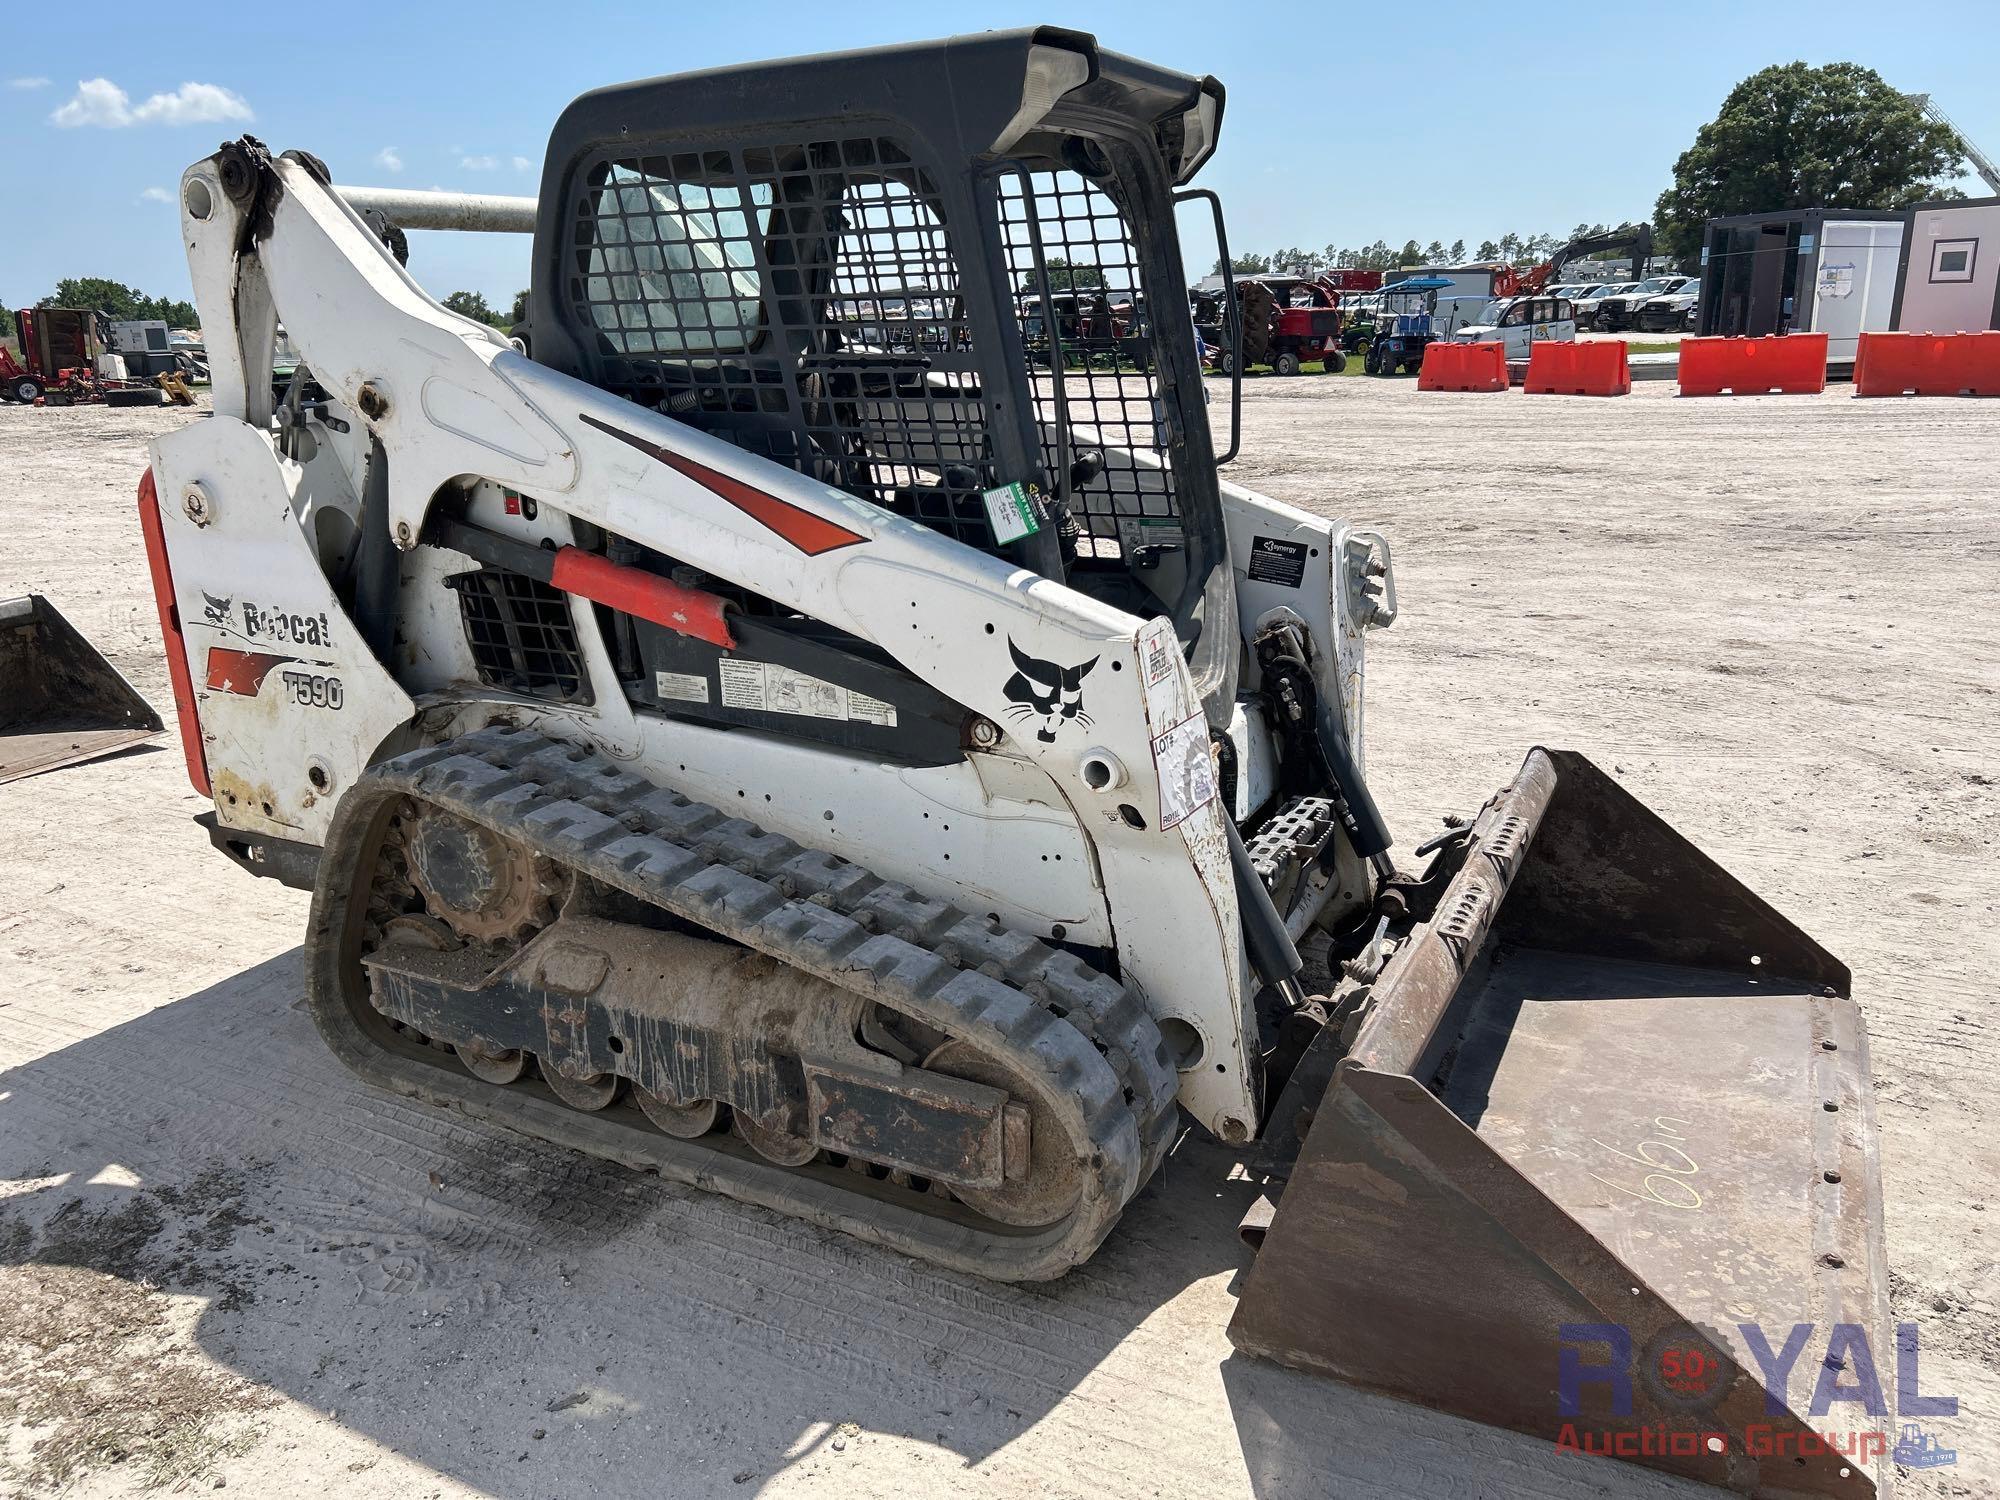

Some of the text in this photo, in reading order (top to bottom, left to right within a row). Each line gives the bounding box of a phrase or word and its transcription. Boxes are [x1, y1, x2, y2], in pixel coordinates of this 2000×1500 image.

[1015, 482, 1028, 503] READY
[1024, 504, 1031, 513] TO
[1027, 513, 1039, 530] RENT
[1273, 544, 1297, 554] synergy
[242, 602, 332, 648] Bobcat
[282, 671, 344, 710] T590
